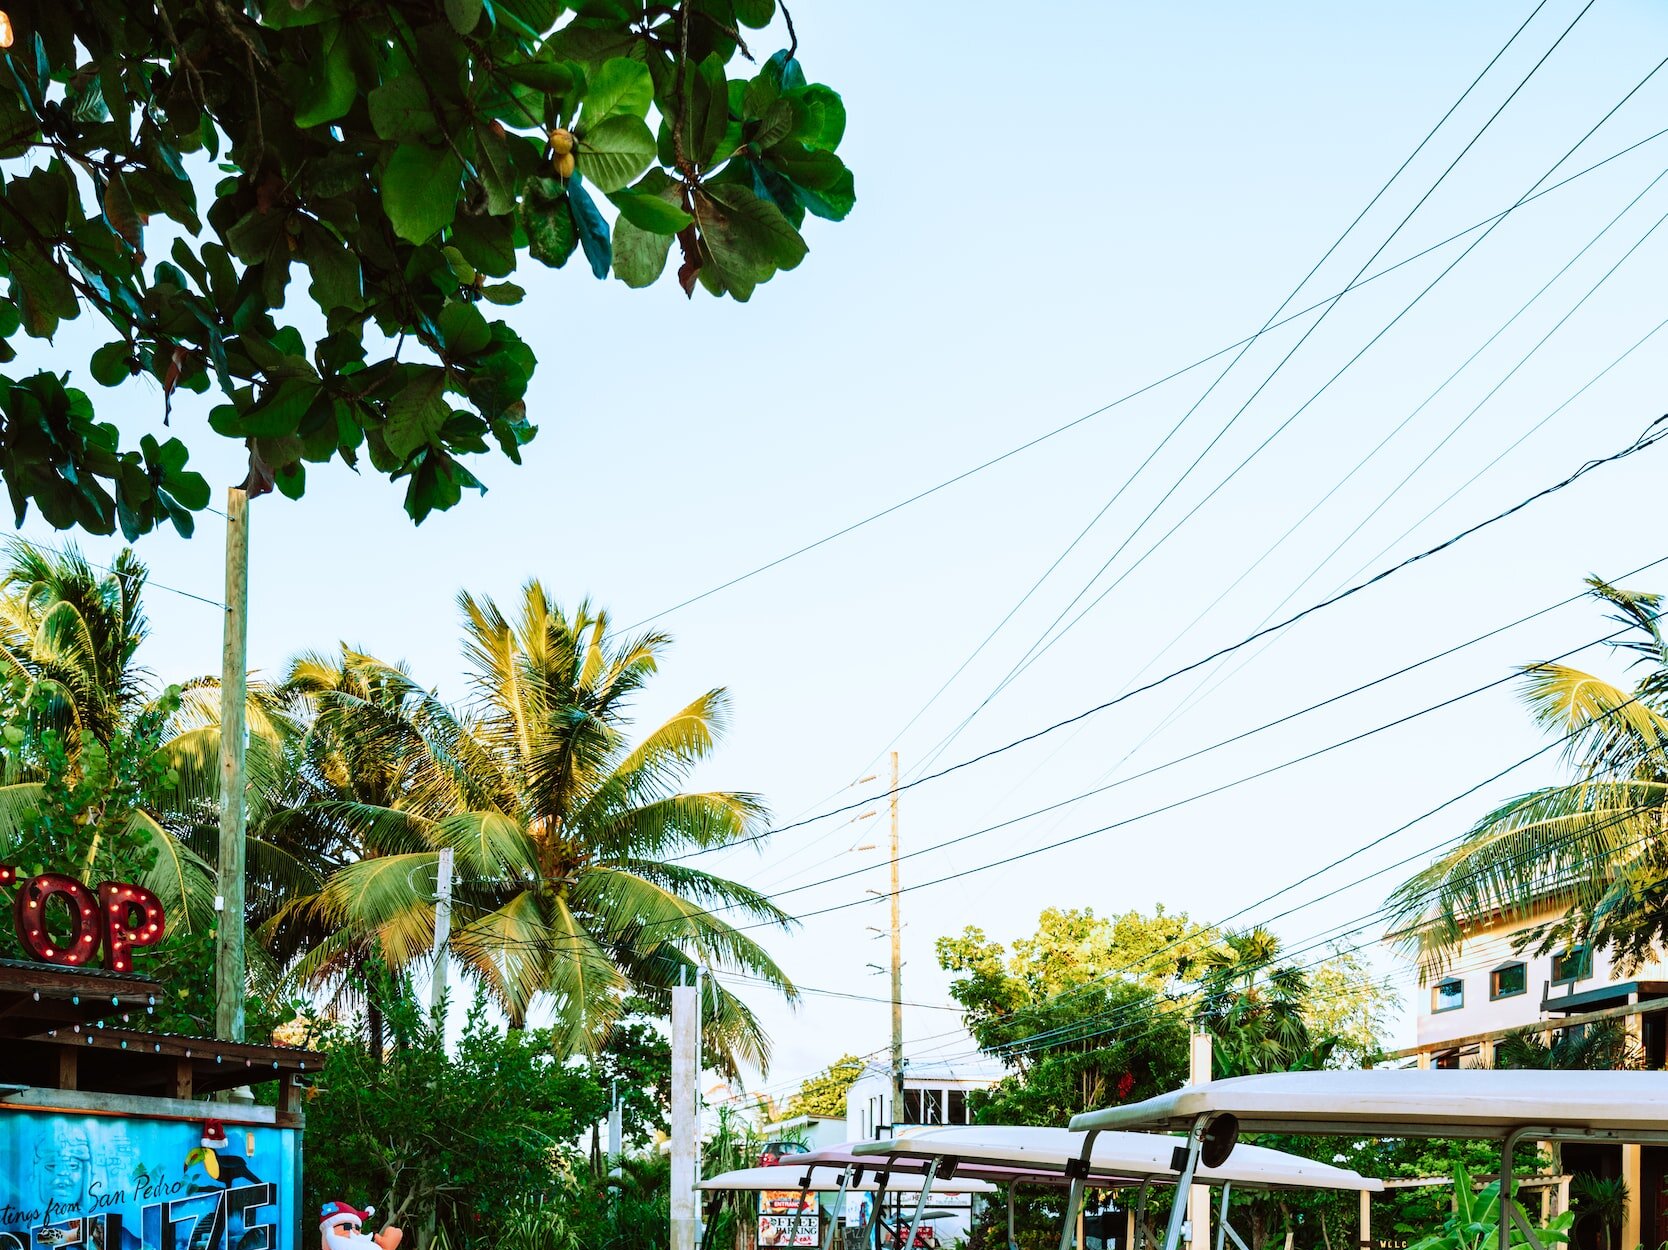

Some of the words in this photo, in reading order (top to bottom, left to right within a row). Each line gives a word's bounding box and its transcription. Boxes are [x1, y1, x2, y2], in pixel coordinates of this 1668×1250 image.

[0, 864, 165, 971] OP
[43, 1198, 81, 1227] from
[88, 1181, 125, 1213] San
[133, 1174, 184, 1201] Pedro
[778, 1217, 818, 1227] FREE
